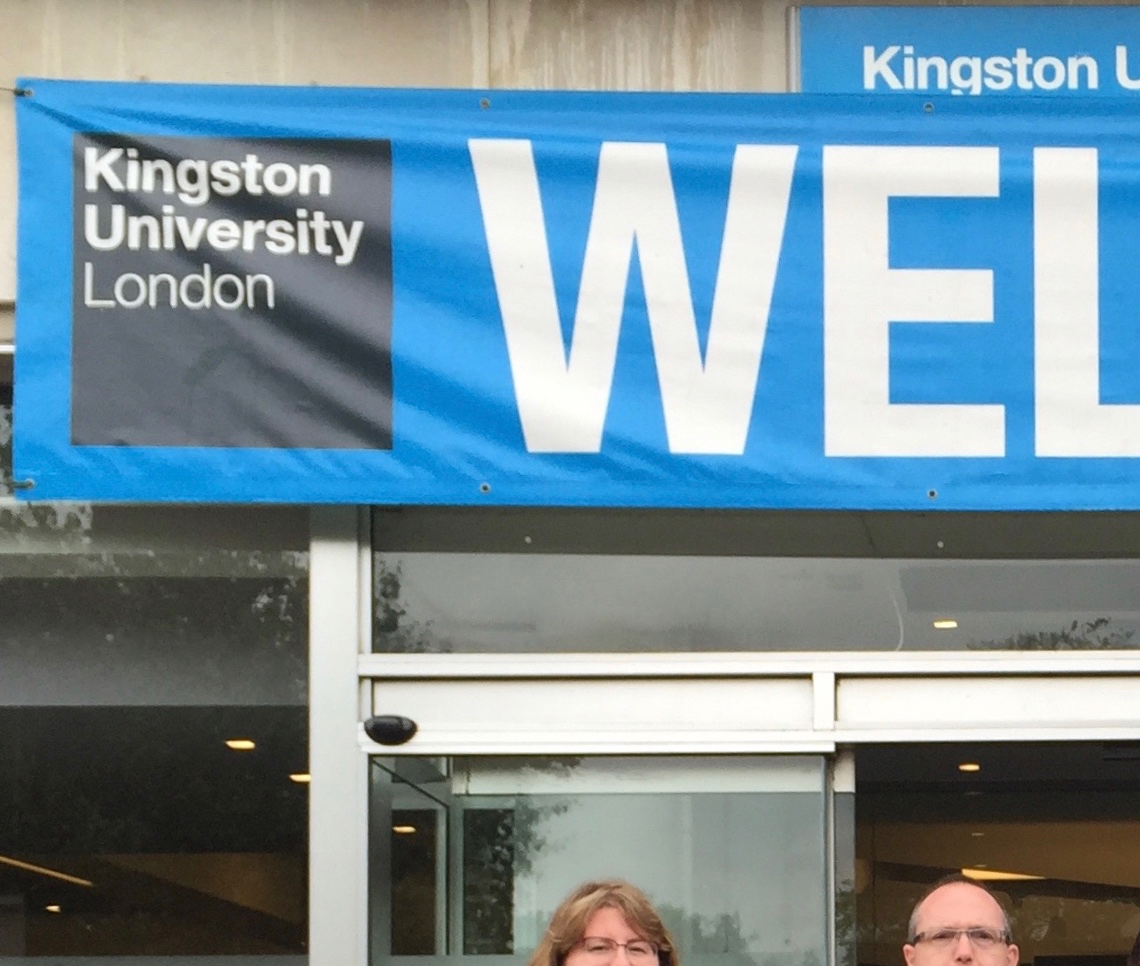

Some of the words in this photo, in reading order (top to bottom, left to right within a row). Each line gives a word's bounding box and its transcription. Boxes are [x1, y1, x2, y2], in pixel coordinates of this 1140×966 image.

[863, 44, 1098, 95] Kingston
[84, 146, 332, 206] Kingston
[84, 204, 364, 265] University
[84, 261, 275, 309] London
